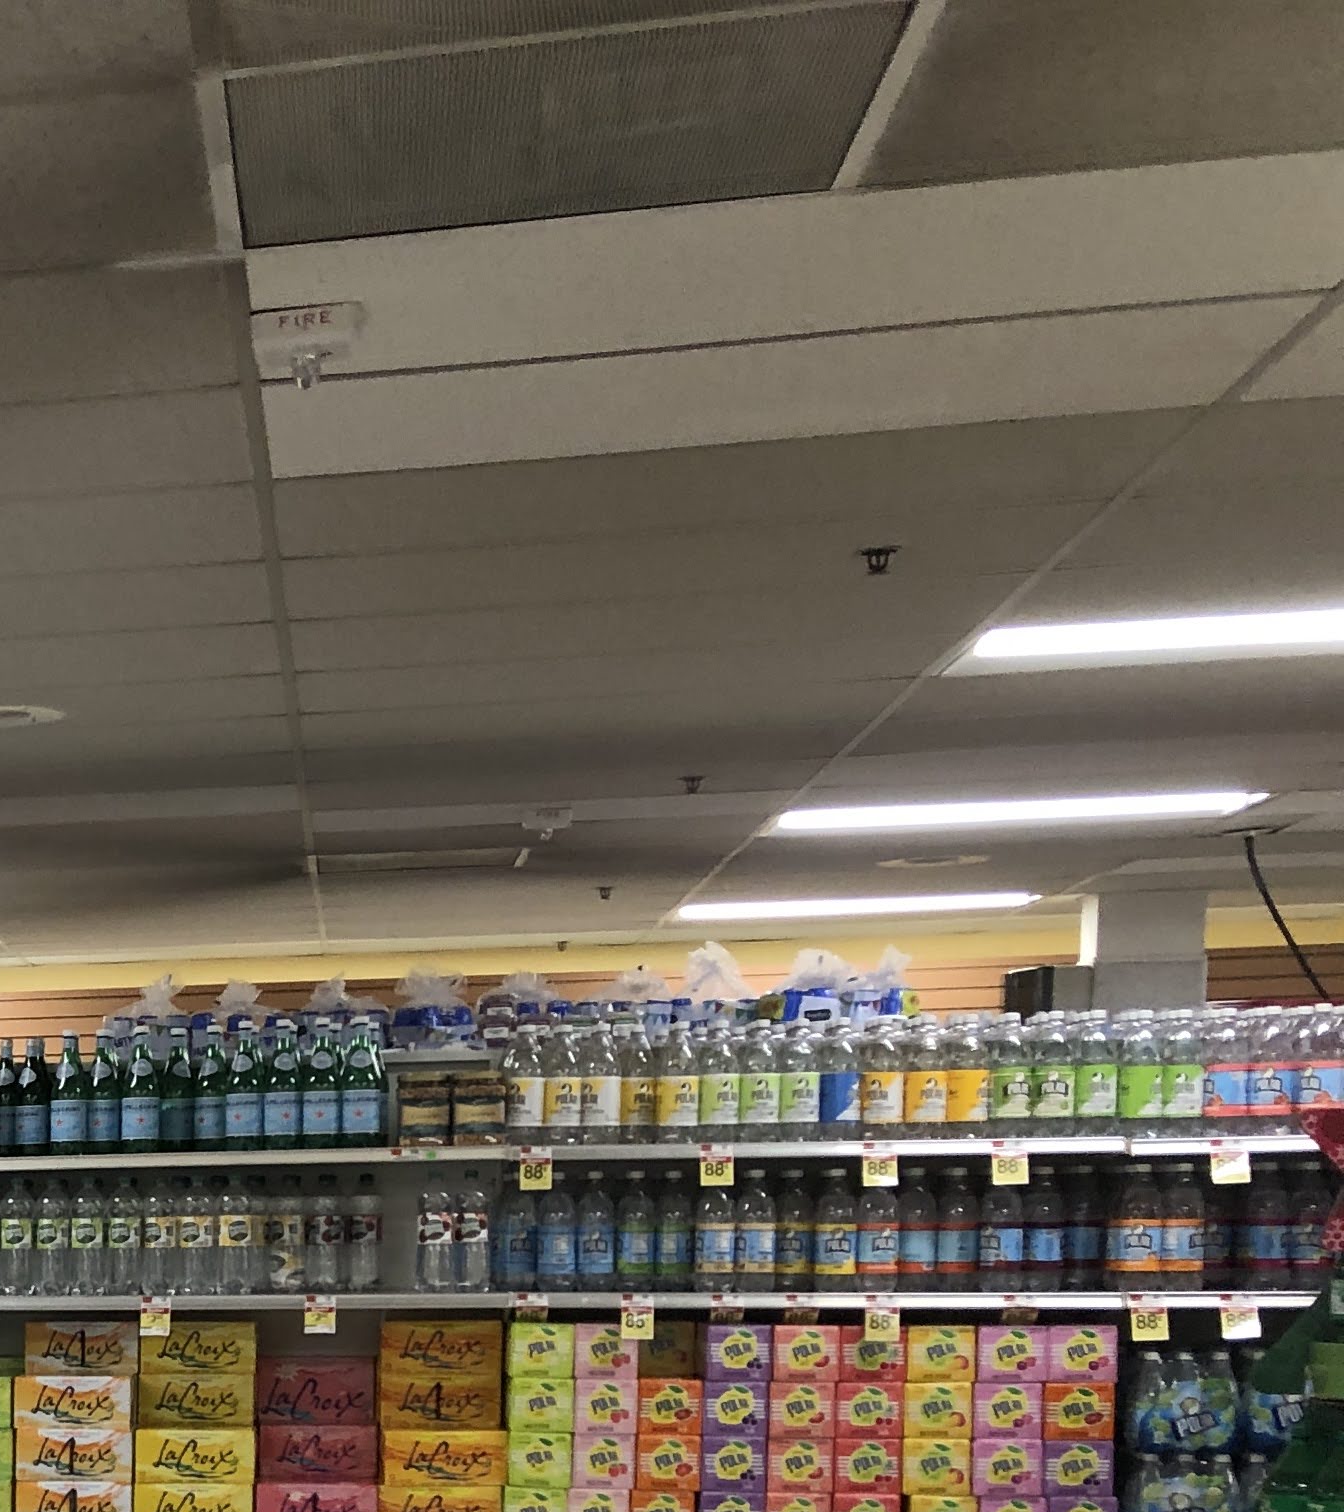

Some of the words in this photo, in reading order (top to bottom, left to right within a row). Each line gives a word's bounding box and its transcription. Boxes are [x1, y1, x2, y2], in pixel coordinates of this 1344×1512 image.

[278, 309, 333, 330] FIRE
[158, 1330, 237, 1360] LaCroix
[403, 1330, 481, 1358] LaCroix
[32, 1387, 108, 1413] LaCroix
[157, 1383, 237, 1411] LaCroix
[264, 1378, 361, 1410] LaCroix
[154, 1441, 235, 1469] LaCroix
[405, 1443, 485, 1472] LaCroix
